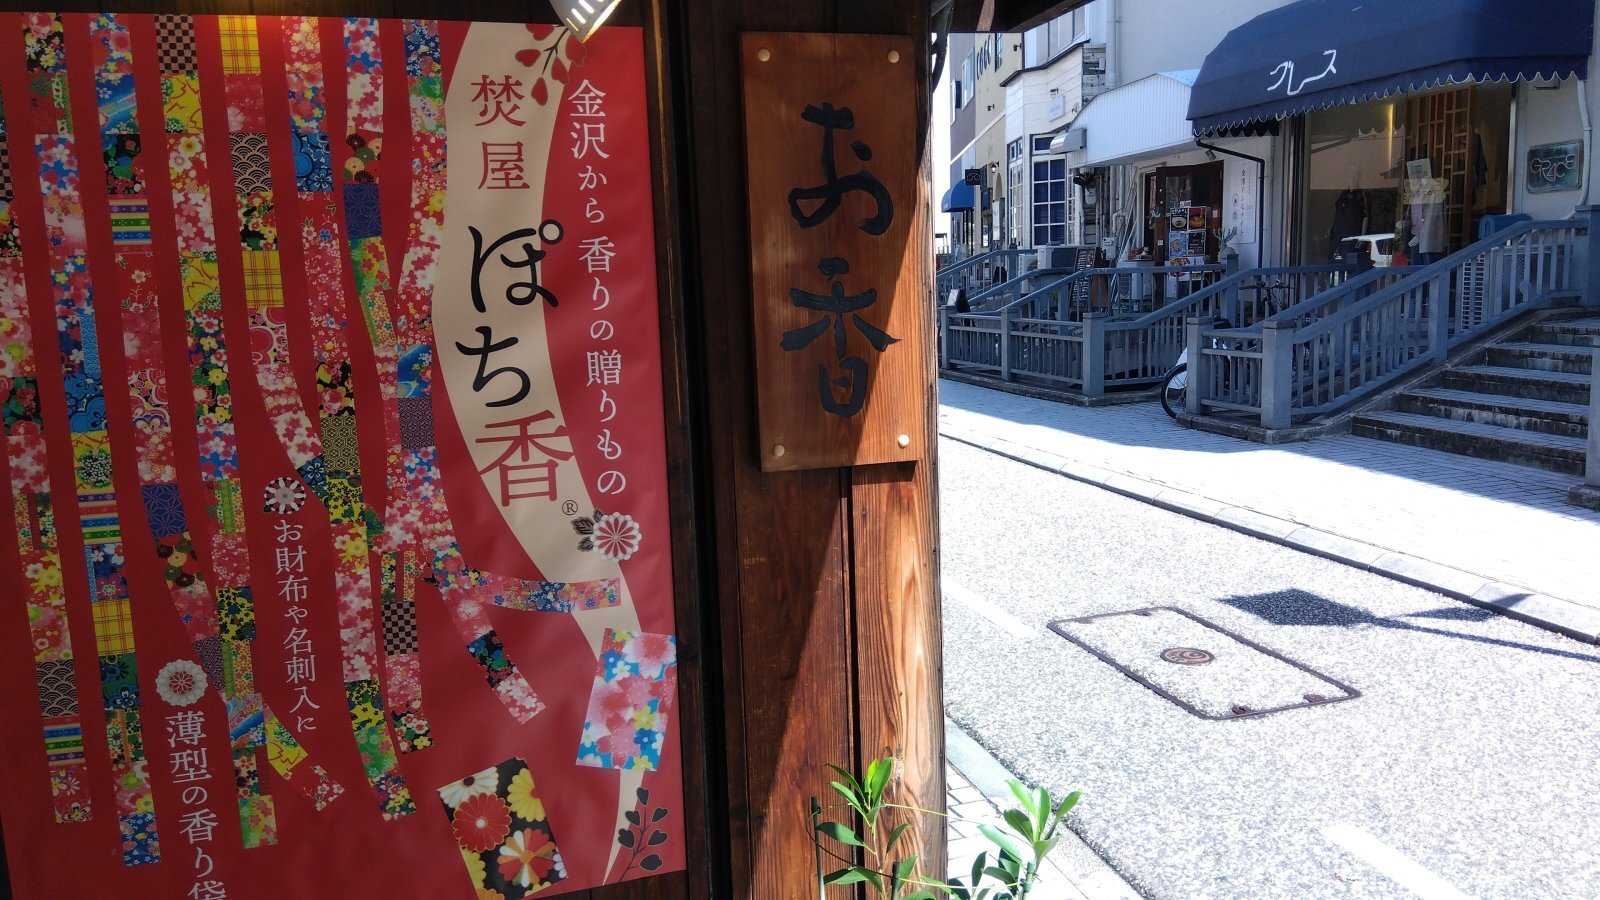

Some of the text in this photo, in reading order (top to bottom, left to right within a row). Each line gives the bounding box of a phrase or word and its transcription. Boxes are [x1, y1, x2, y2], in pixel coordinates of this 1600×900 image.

[470, 74, 531, 190] 焚屋
[1530, 153, 1576, 184] GRACE
[568, 79, 627, 495] 金沢から香りの贈りもの
[779, 101, 904, 418] お香
[273, 518, 321, 733] お財布や名刺入に
